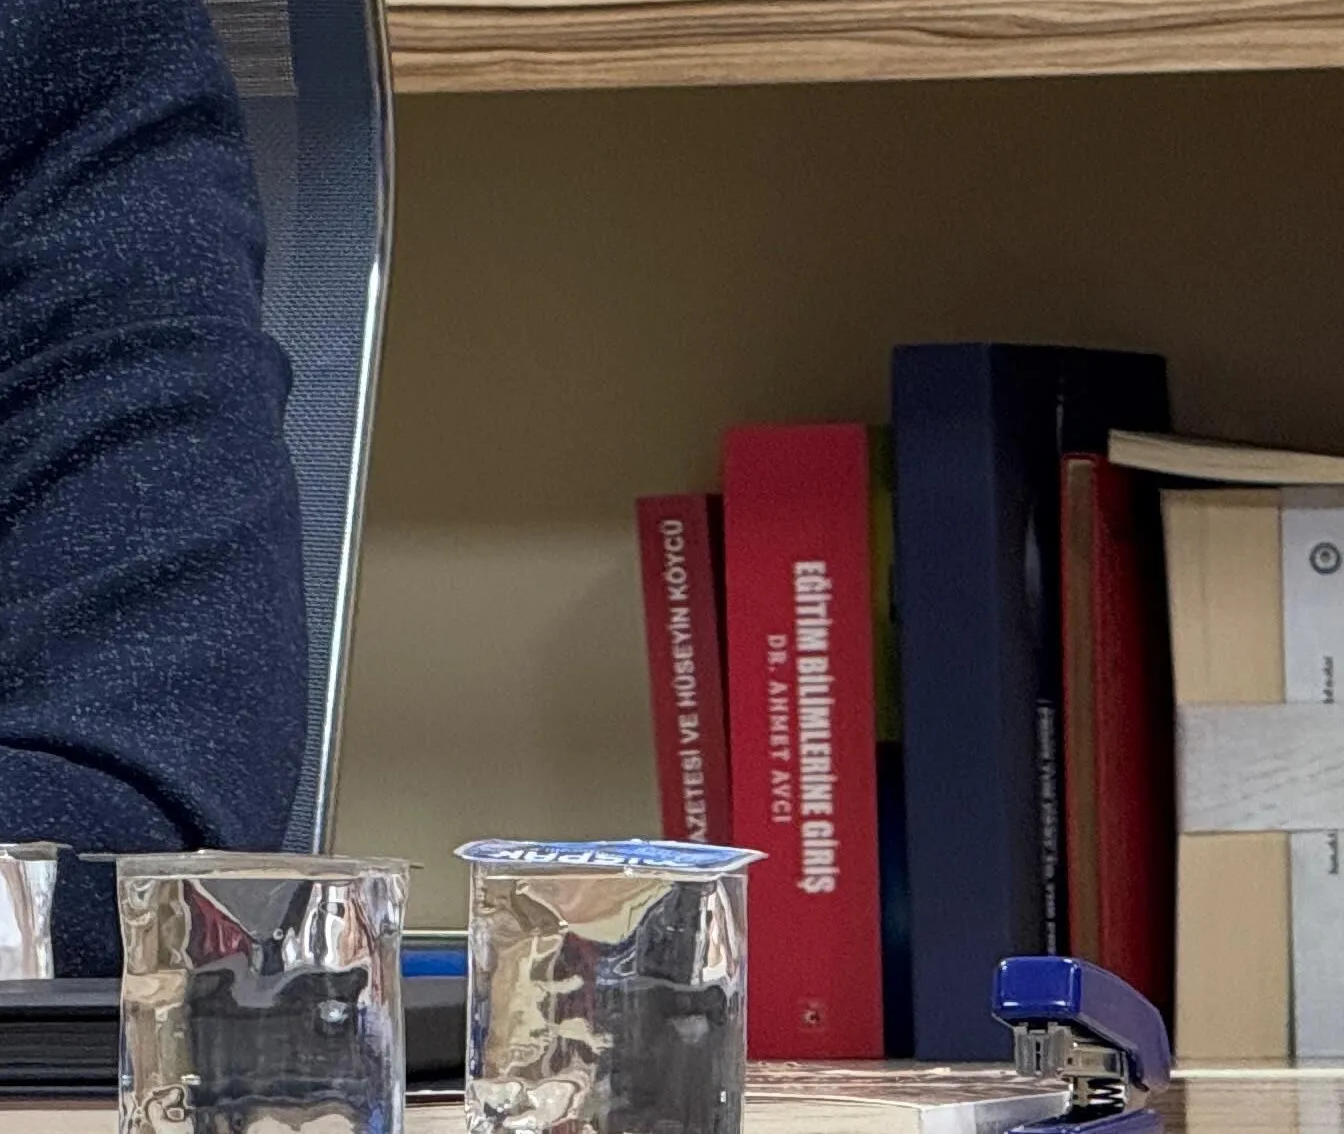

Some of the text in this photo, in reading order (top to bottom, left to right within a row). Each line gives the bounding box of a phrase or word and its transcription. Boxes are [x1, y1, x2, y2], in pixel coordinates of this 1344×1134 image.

[660, 519, 706, 843] AZETESİ VE HÜSEYİN KÖYCÜ
[767, 634, 792, 823] DR. AHMET AVCI
[794, 561, 841, 893] EĞİTİM BİLİMLERİNE GİRİŞ
